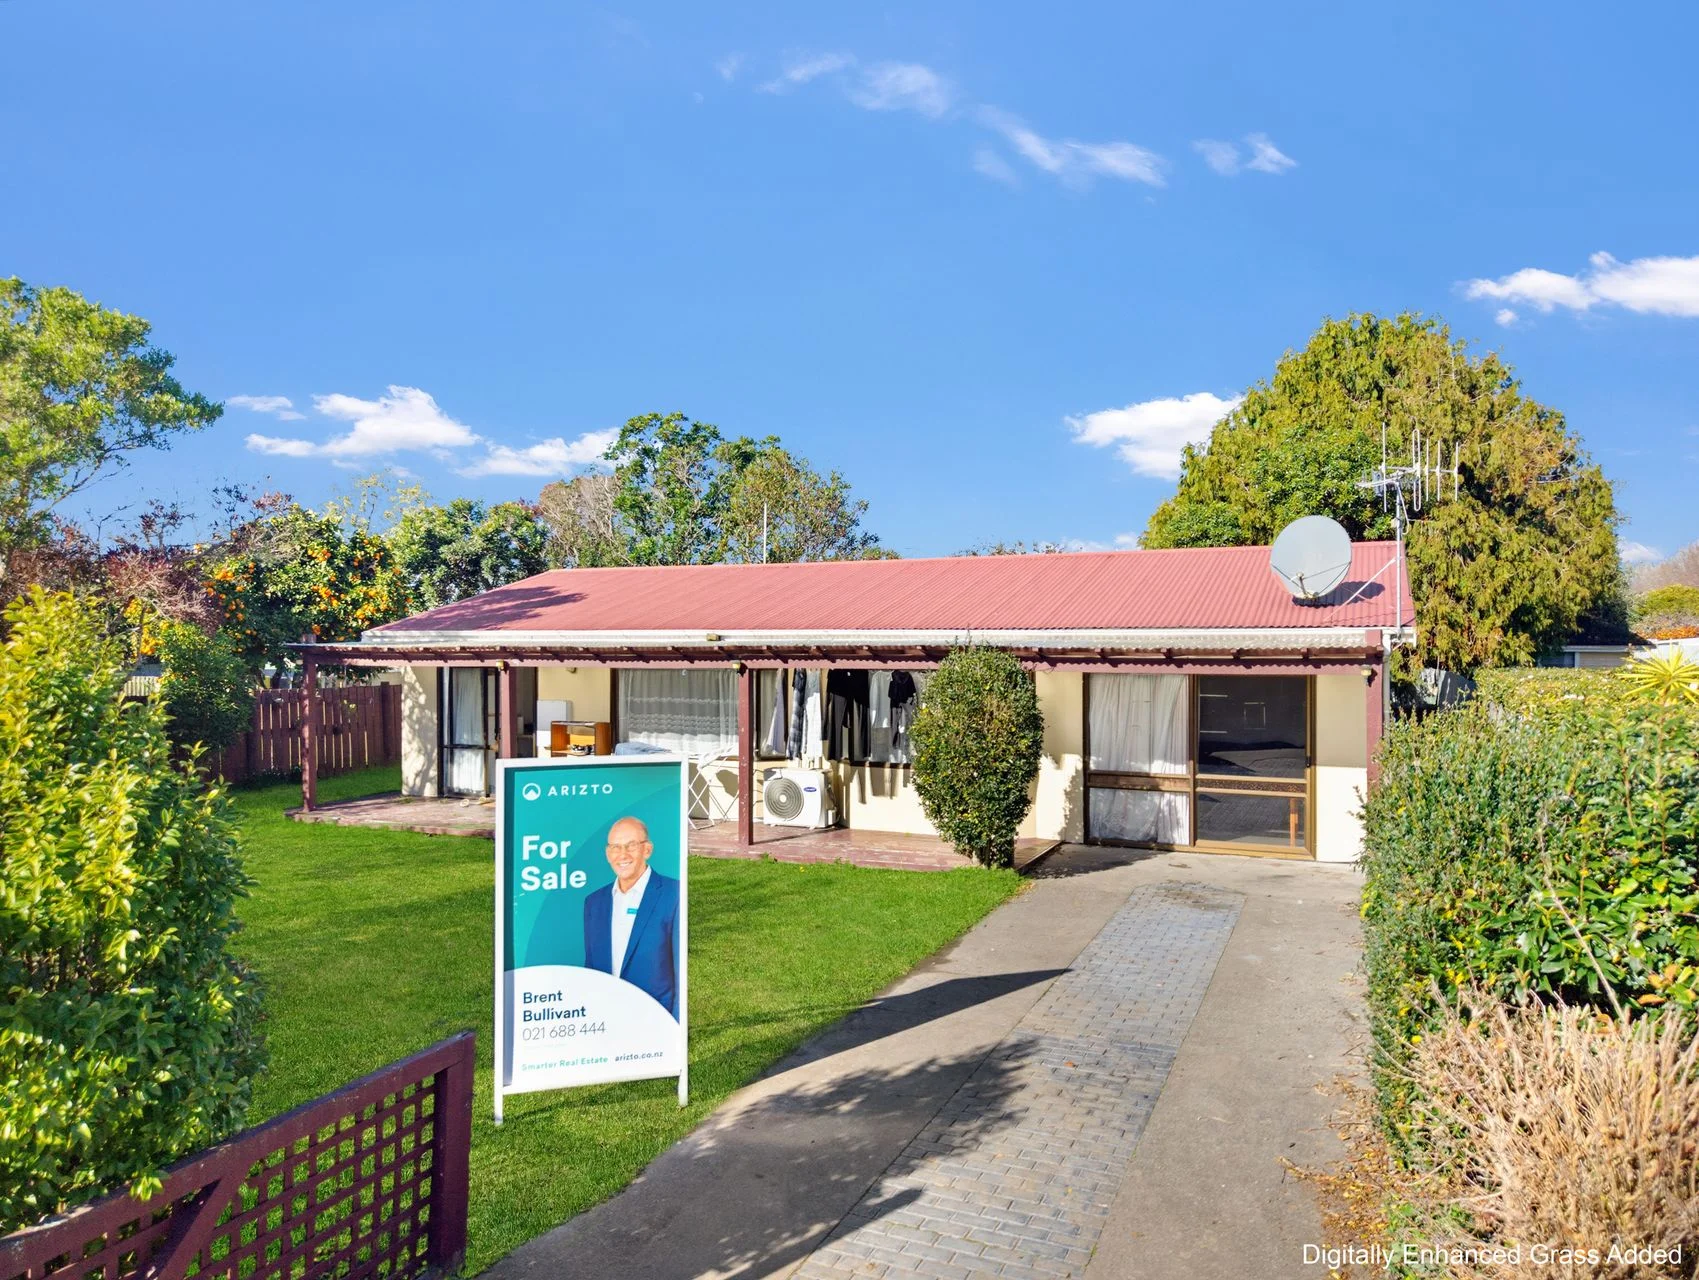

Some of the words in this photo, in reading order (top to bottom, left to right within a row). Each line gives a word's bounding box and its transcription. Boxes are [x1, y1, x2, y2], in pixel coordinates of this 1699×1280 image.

[548, 783, 613, 796] ARIZTO
[522, 835, 571, 861] For
[521, 863, 587, 891] Sale
[523, 990, 563, 1004] Brent
[523, 1006, 587, 1022] Bullivant
[522, 1026, 546, 1041] 021
[549, 1024, 576, 1038] 688
[579, 1021, 606, 1036] 444
[521, 1060, 557, 1071] Smarter
[559, 1058, 579, 1068] Real
[580, 1056, 608, 1066] Estate
[614, 1050, 664, 1062] arizto.co.nz
